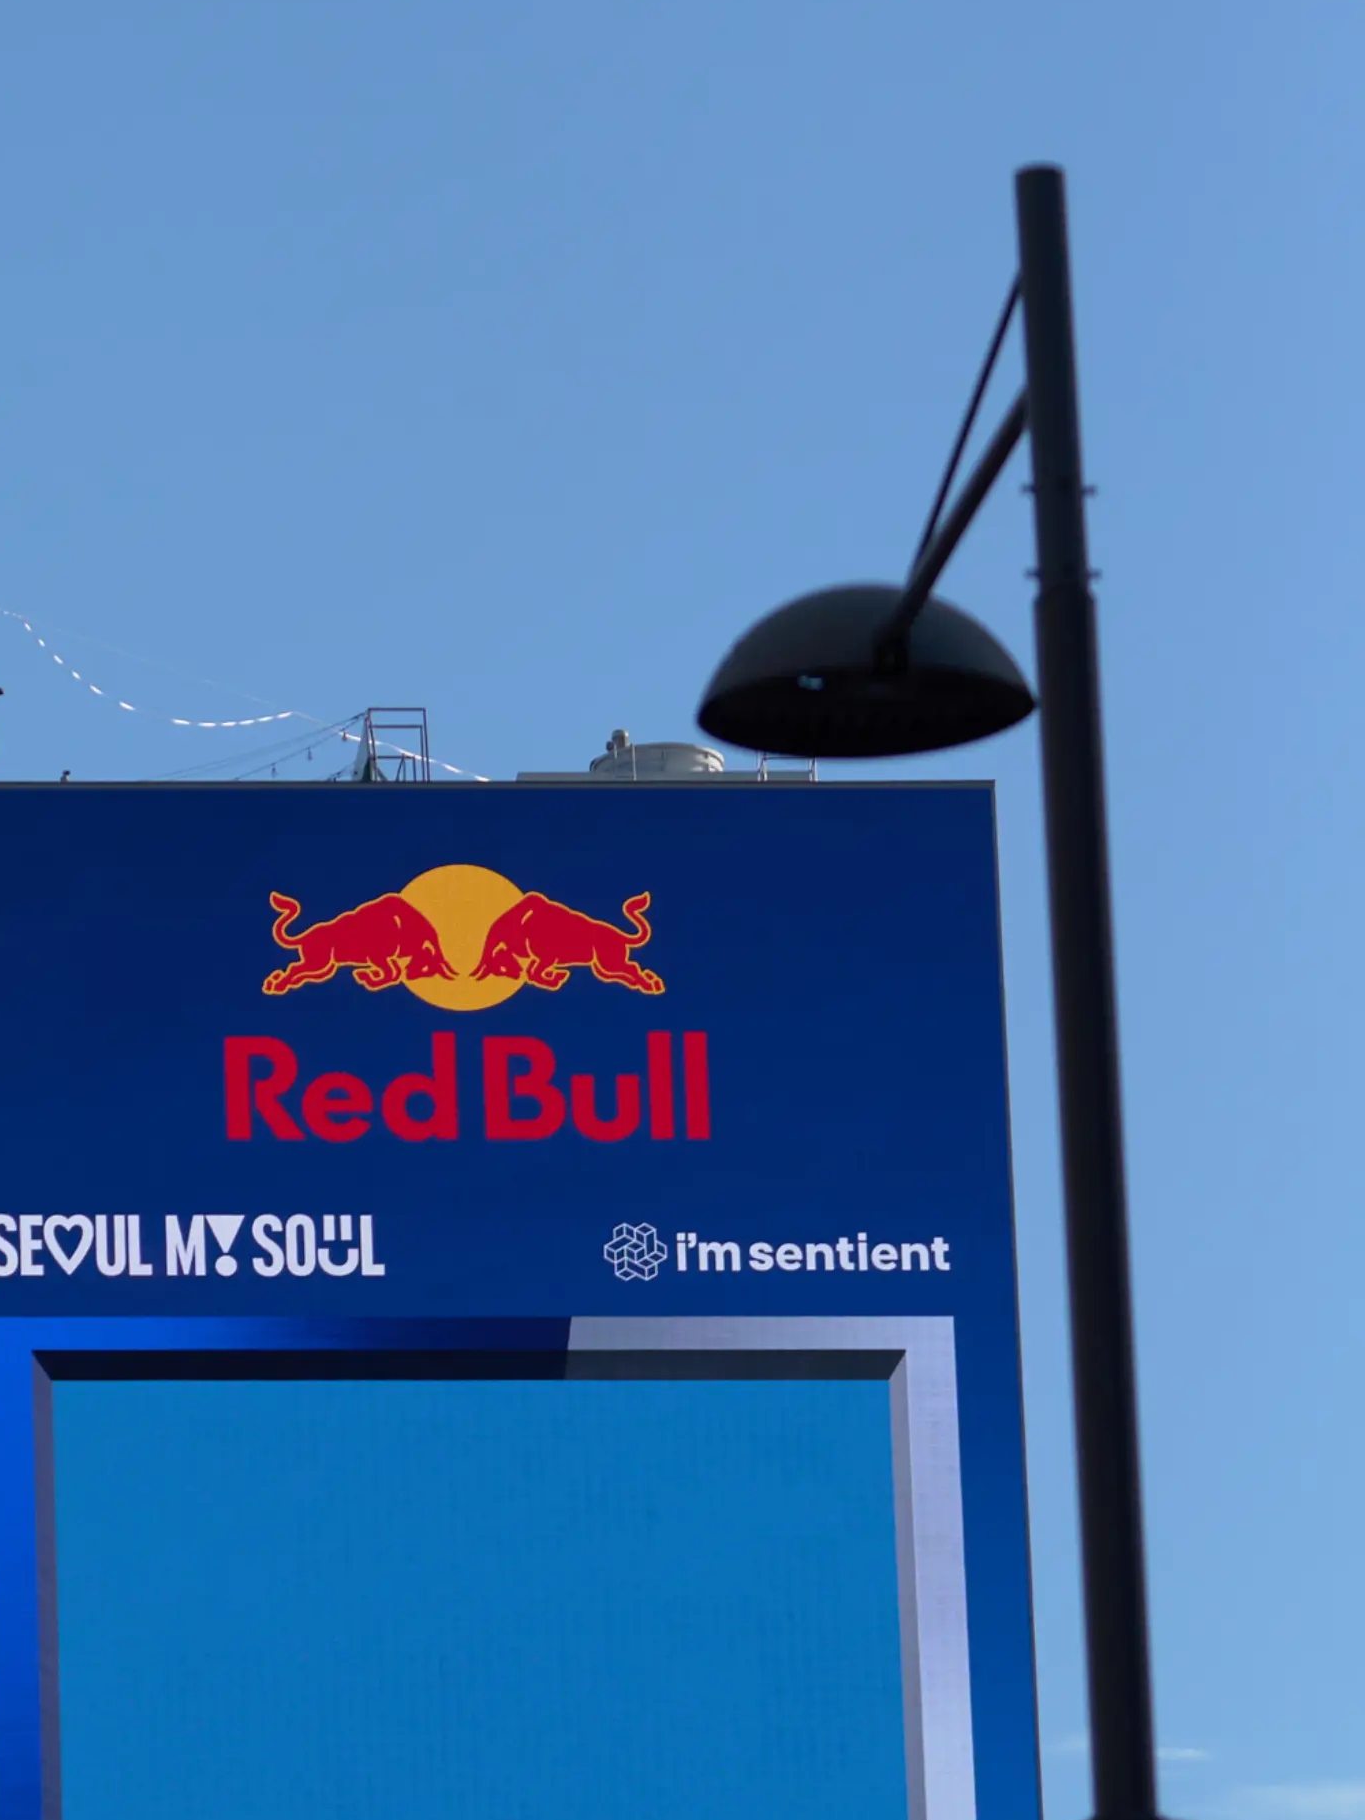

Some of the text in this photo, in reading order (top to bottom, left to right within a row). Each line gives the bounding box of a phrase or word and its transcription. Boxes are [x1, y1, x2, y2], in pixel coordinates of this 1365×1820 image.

[224, 1031, 710, 1142] Red Bull
[251, 1213, 386, 1277] SOUL
[676, 1232, 950, 1272] i'm sentient
